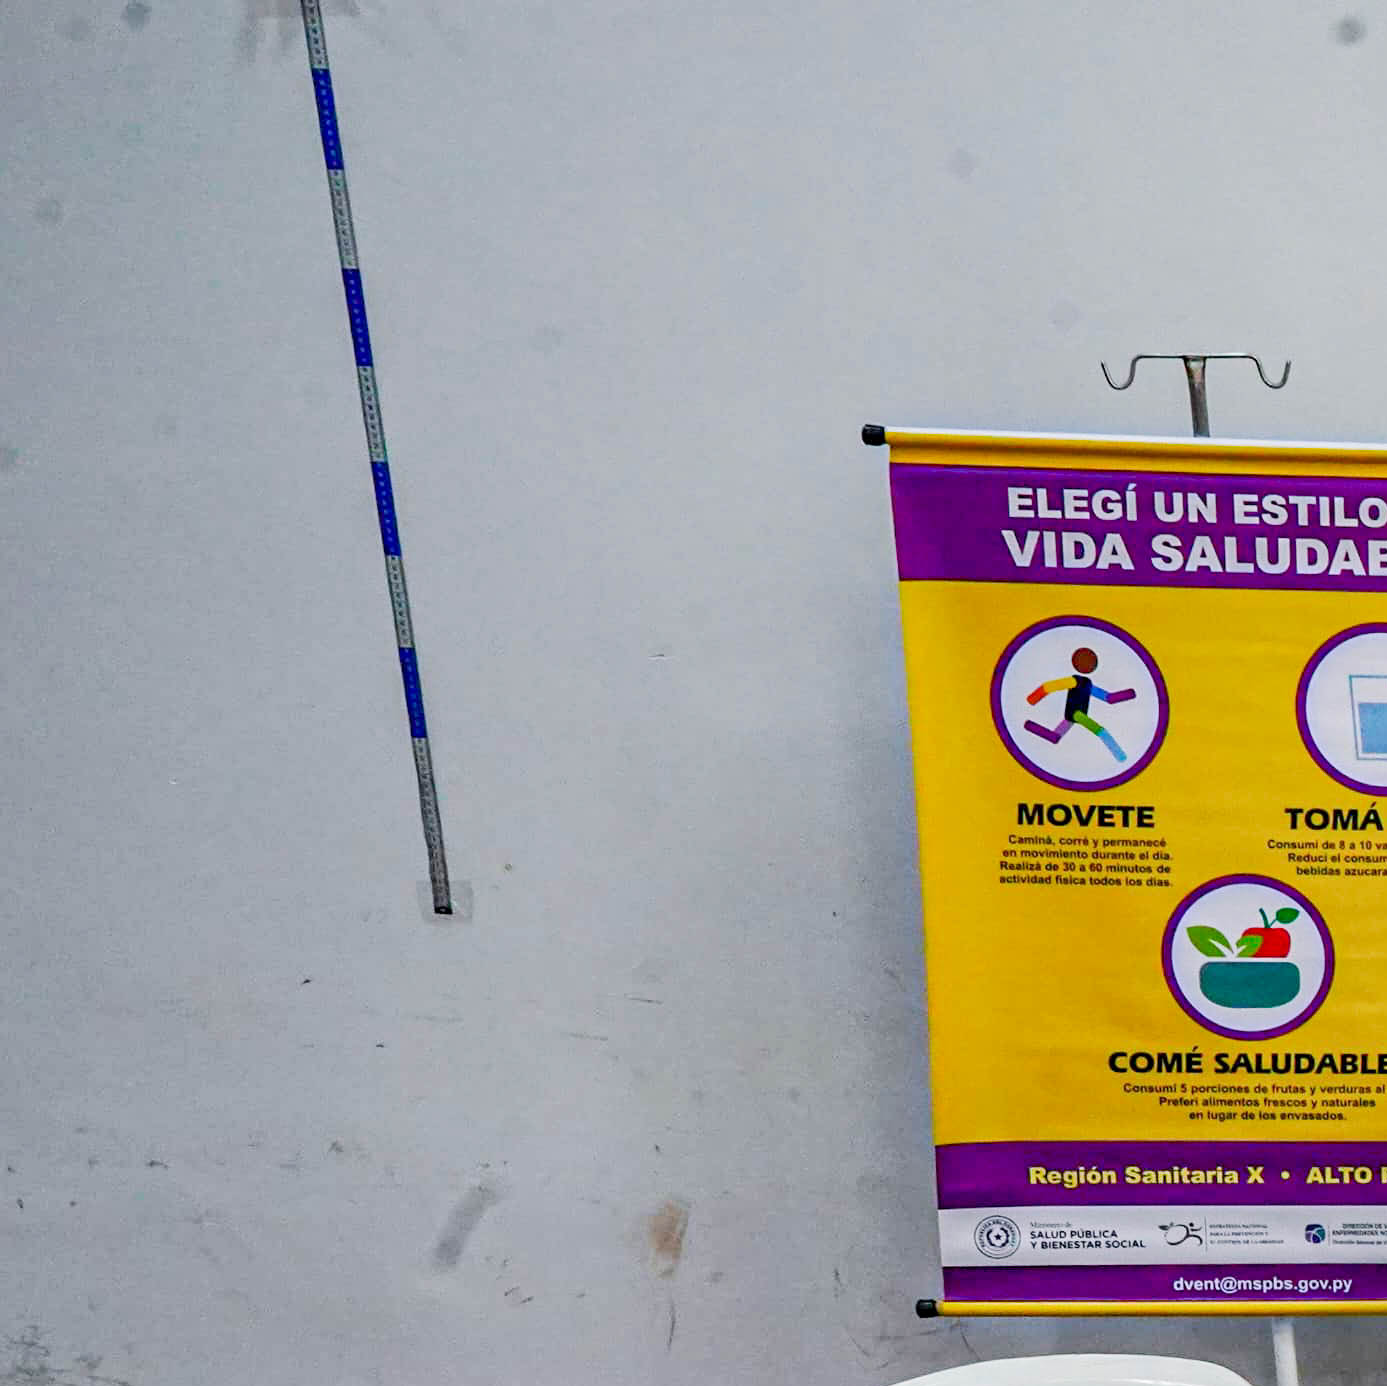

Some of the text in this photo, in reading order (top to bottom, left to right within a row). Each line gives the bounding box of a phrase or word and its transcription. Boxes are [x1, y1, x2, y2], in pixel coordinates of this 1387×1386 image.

[1008, 484, 1138, 521] ELEGÍ
[1154, 494, 1218, 524] UN
[1001, 530, 1135, 570] VIDA
[1016, 804, 1156, 829] MOVETE
[1285, 803, 1384, 831] TOMÁ
[1322, 840, 1336, 850] de
[1359, 841, 1372, 850] 10
[1002, 849, 1136, 861] en movimiento durante
[1045, 862, 1059, 872] de
[1063, 862, 1076, 872] 30
[1089, 862, 1103, 873] 60
[1106, 864, 1153, 873] minutos
[1156, 864, 1171, 874] de
[1296, 866, 1341, 876] bebidas
[999, 875, 1143, 887] actividad todos los
[1108, 1046, 1204, 1074] COMÉ
[1191, 1084, 1372, 1095] porciones frutas verduras
[1202, 1097, 1376, 1108] alimentos frescos naturales
[1207, 1111, 1237, 1122] lugar
[1029, 1165, 1265, 1189] Región Sanitaria X
[1306, 1166, 1373, 1185] ALTO
[1030, 1230, 1068, 1240] SALUD
[1030, 1239, 1147, 1250] Y BIENESTAR SOCIAL
[1173, 1277, 1353, 1294] dvent@mspbs.gov.py
